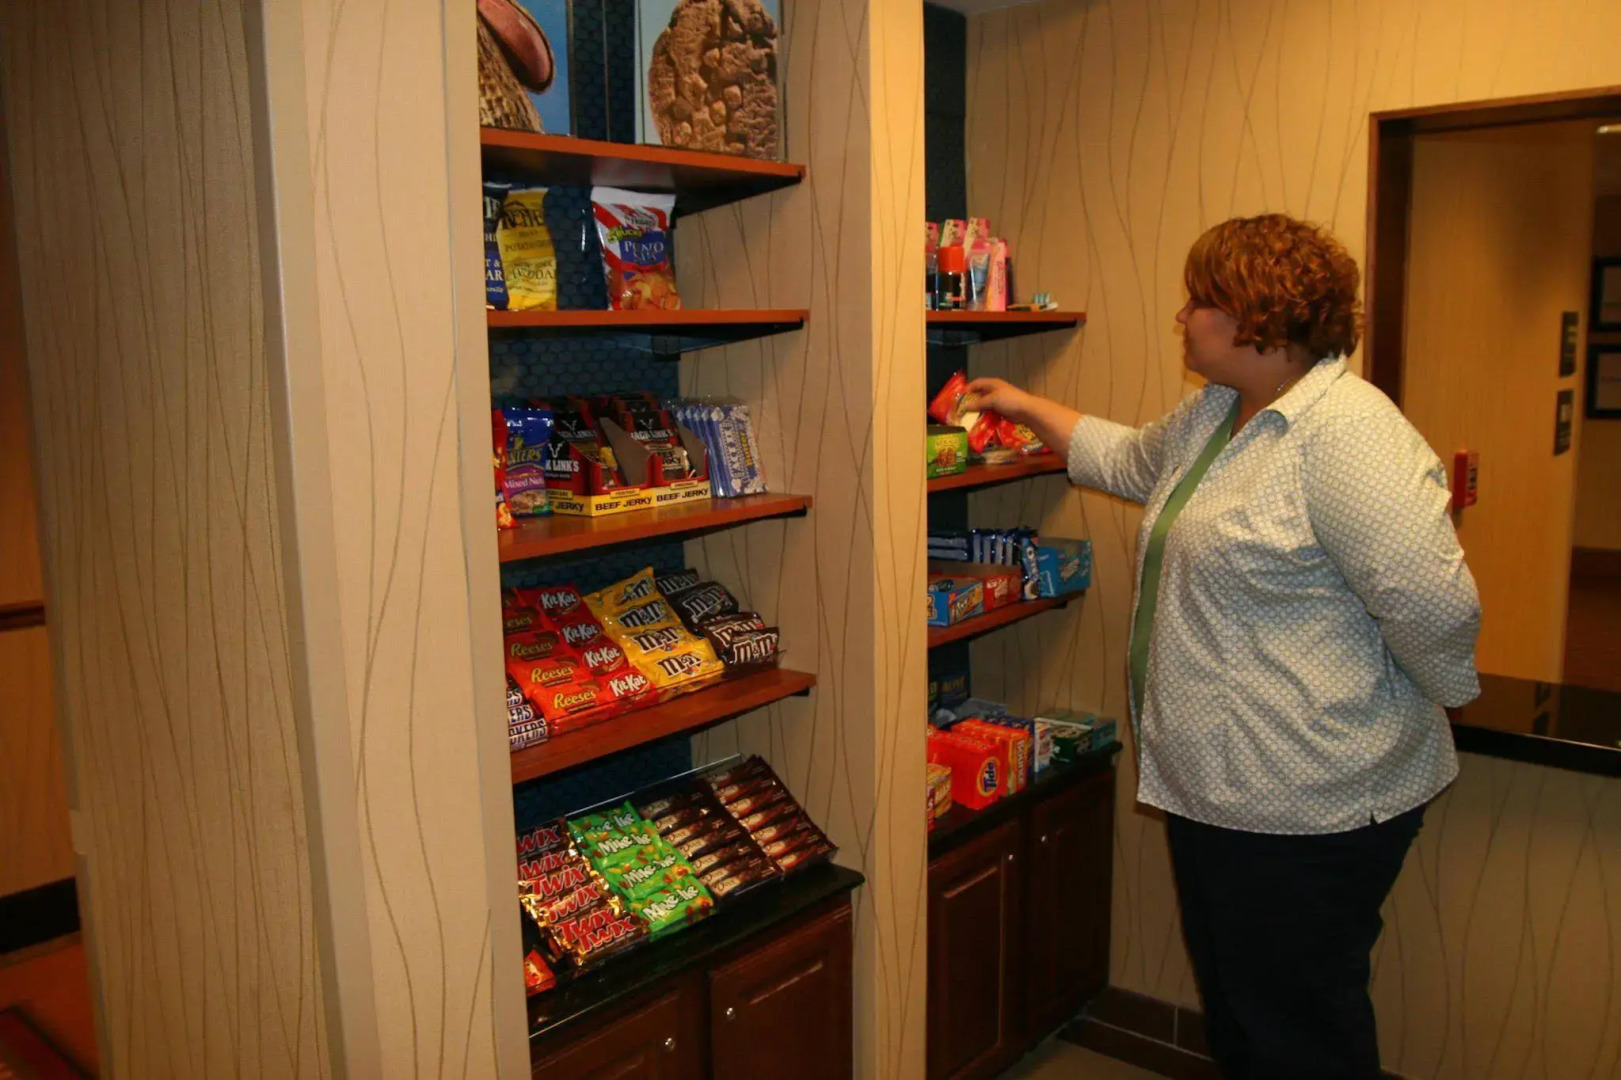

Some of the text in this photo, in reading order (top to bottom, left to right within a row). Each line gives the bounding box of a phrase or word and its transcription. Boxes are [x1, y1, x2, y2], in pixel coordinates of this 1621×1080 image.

[552, 460, 579, 473] LINK'S
[656, 487, 709, 502] BEEF JERKY
[555, 501, 584, 512] JERKY
[595, 496, 652, 511] BEEF JERKY
[983, 761, 997, 793] Tide
[528, 864, 587, 898] Twix
[580, 915, 637, 953] Twix
